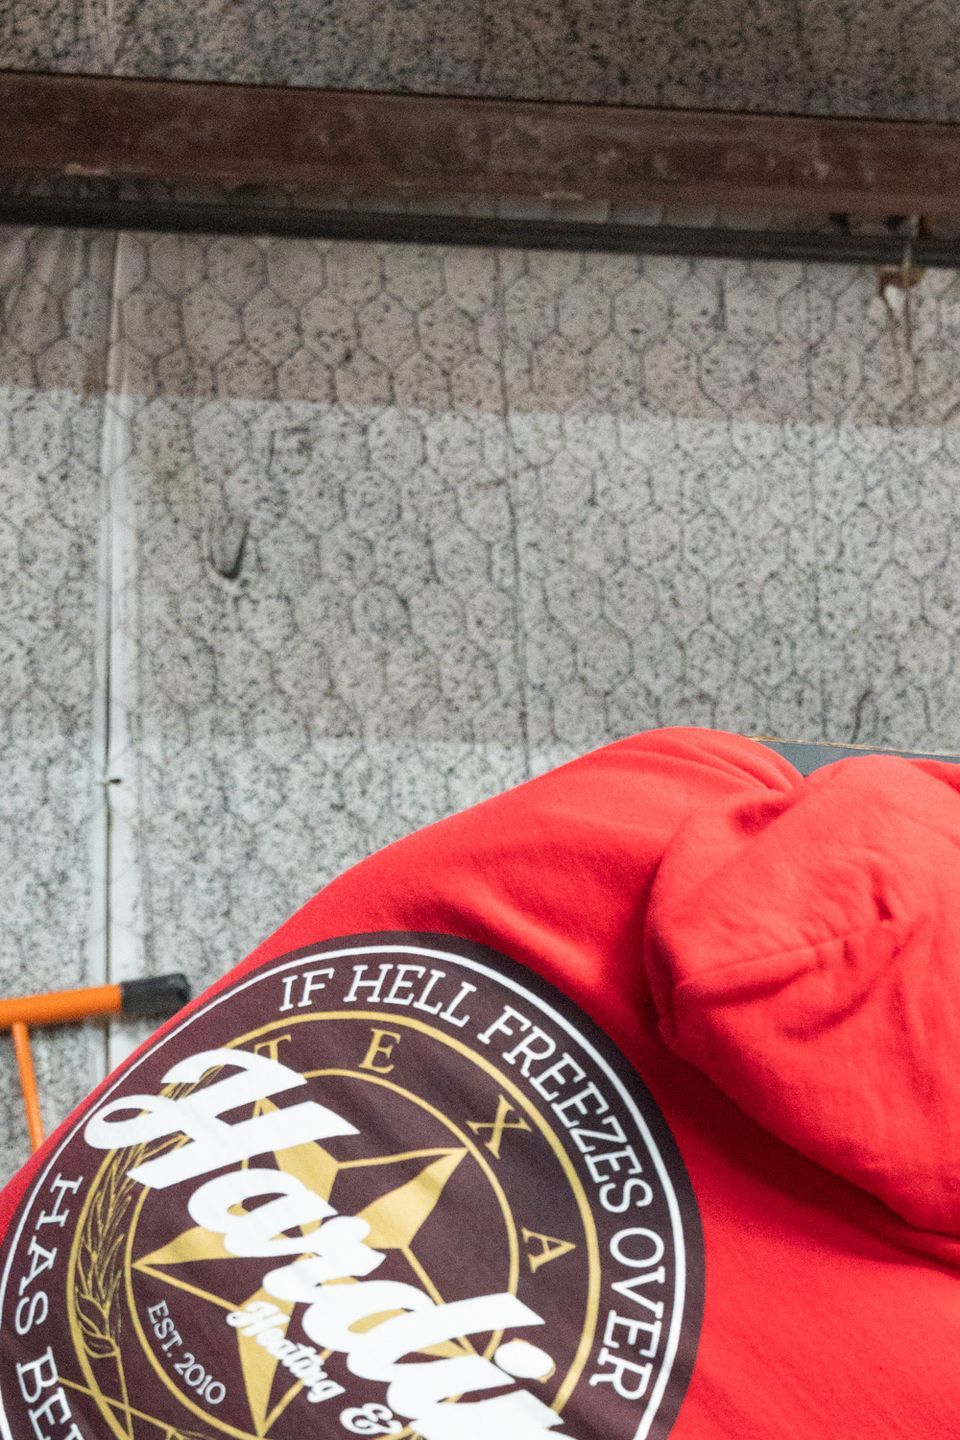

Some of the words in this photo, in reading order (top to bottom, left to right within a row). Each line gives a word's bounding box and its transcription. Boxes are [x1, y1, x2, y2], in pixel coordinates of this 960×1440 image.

[279, 967, 335, 1012] IF
[342, 963, 478, 1028] HELL
[477, 1004, 654, 1215] FREEZES
[588, 1226, 667, 1401] OVER
[14, 1172, 84, 1337] HAS
[146, 1299, 185, 1358] EST.
[173, 1351, 228, 1406] 2010
[225, 1300, 347, 1404] Heating
